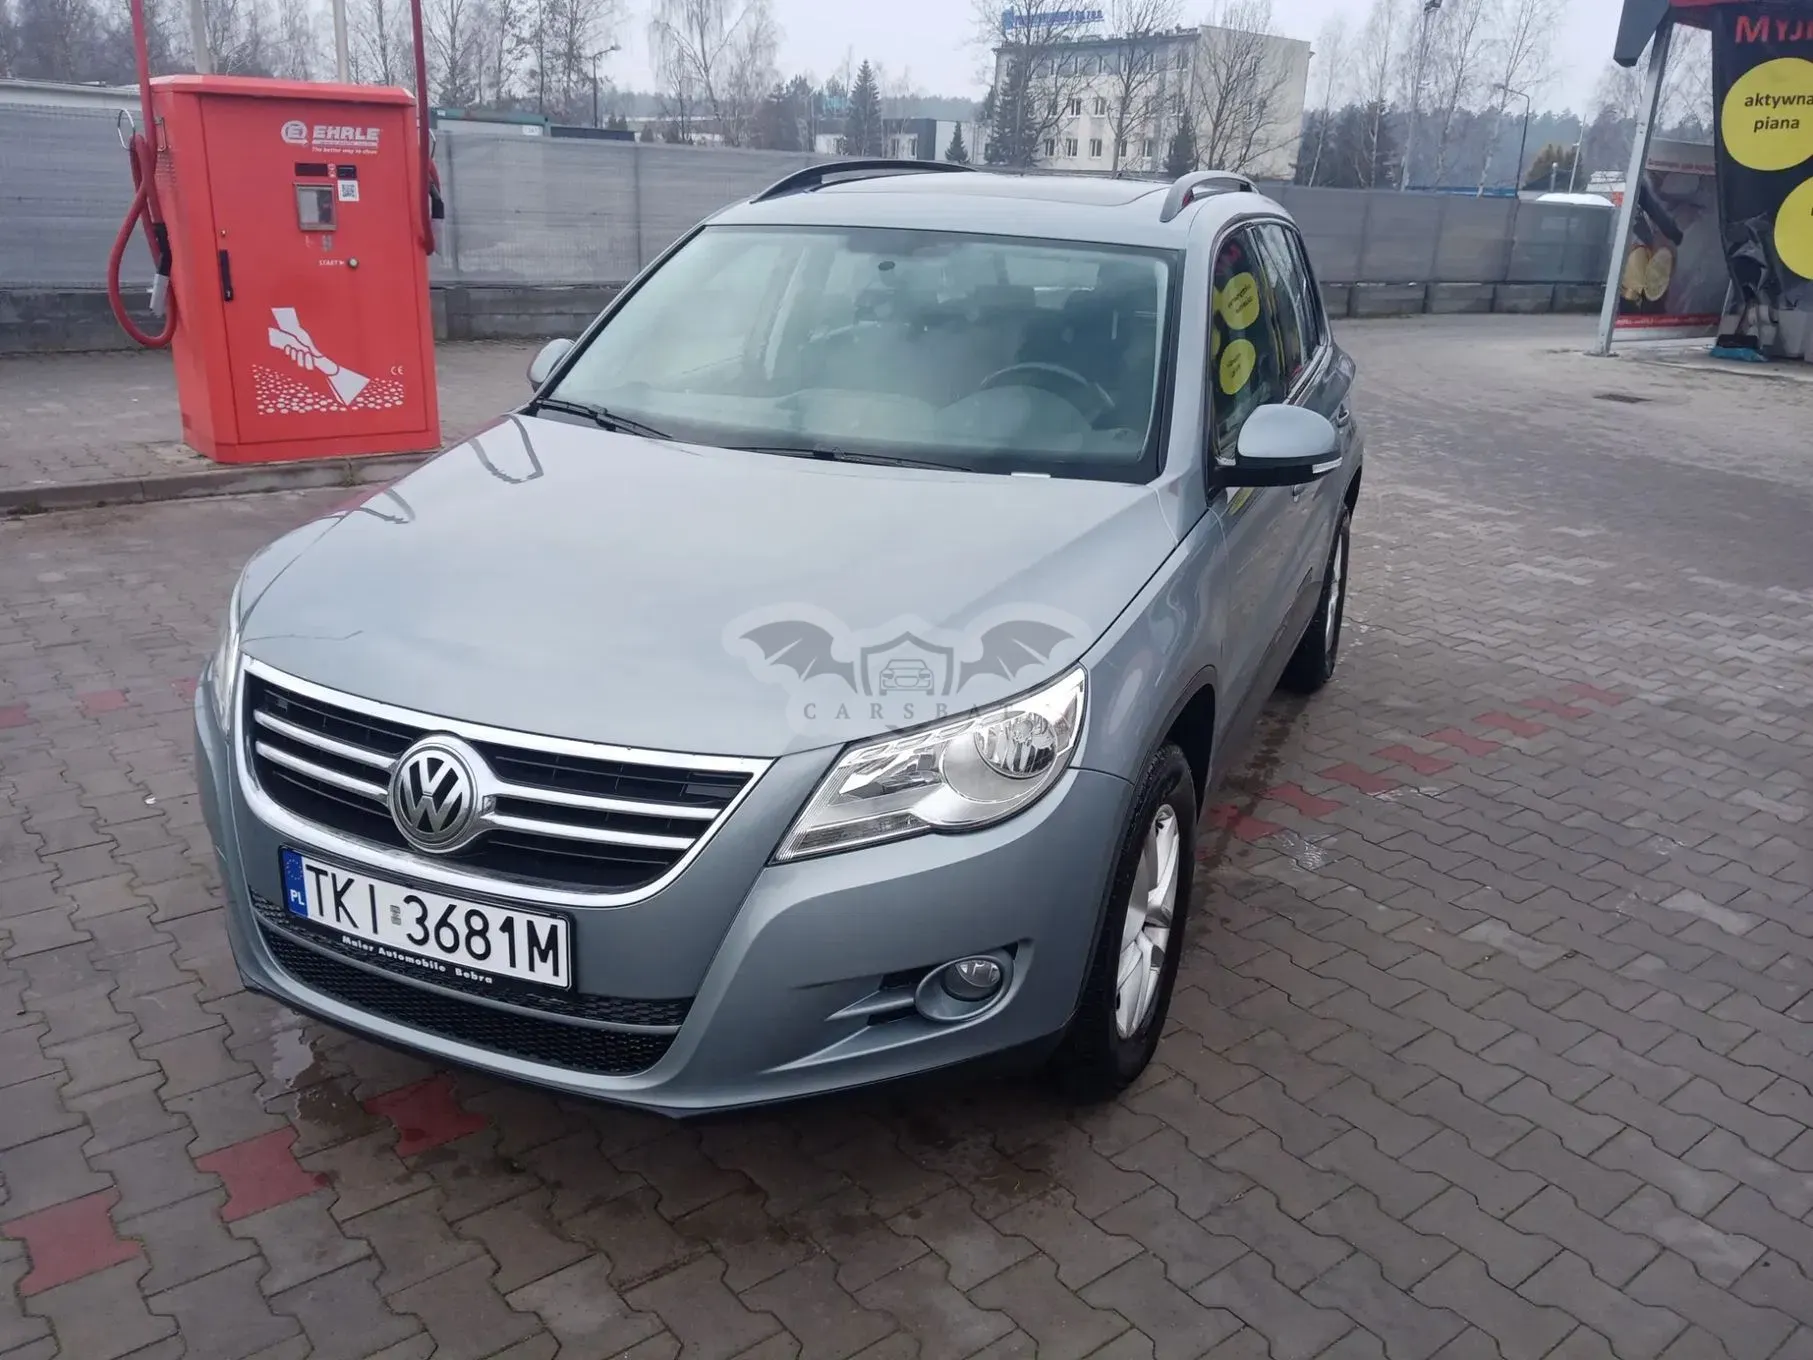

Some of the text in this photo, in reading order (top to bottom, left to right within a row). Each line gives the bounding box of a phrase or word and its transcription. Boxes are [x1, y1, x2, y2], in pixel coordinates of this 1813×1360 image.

[1744, 93, 1813, 109] aktywna
[313, 125, 380, 140] EHRLE
[1753, 116, 1800, 133] piana
[319, 259, 339, 267] START
[390, 365, 404, 376] CE
[397, 748, 470, 838] VW
[289, 888, 305, 906] PL
[305, 863, 560, 977] TKI 3681M
[378, 946, 447, 973] Automobile
[454, 967, 493, 984] Bebra
